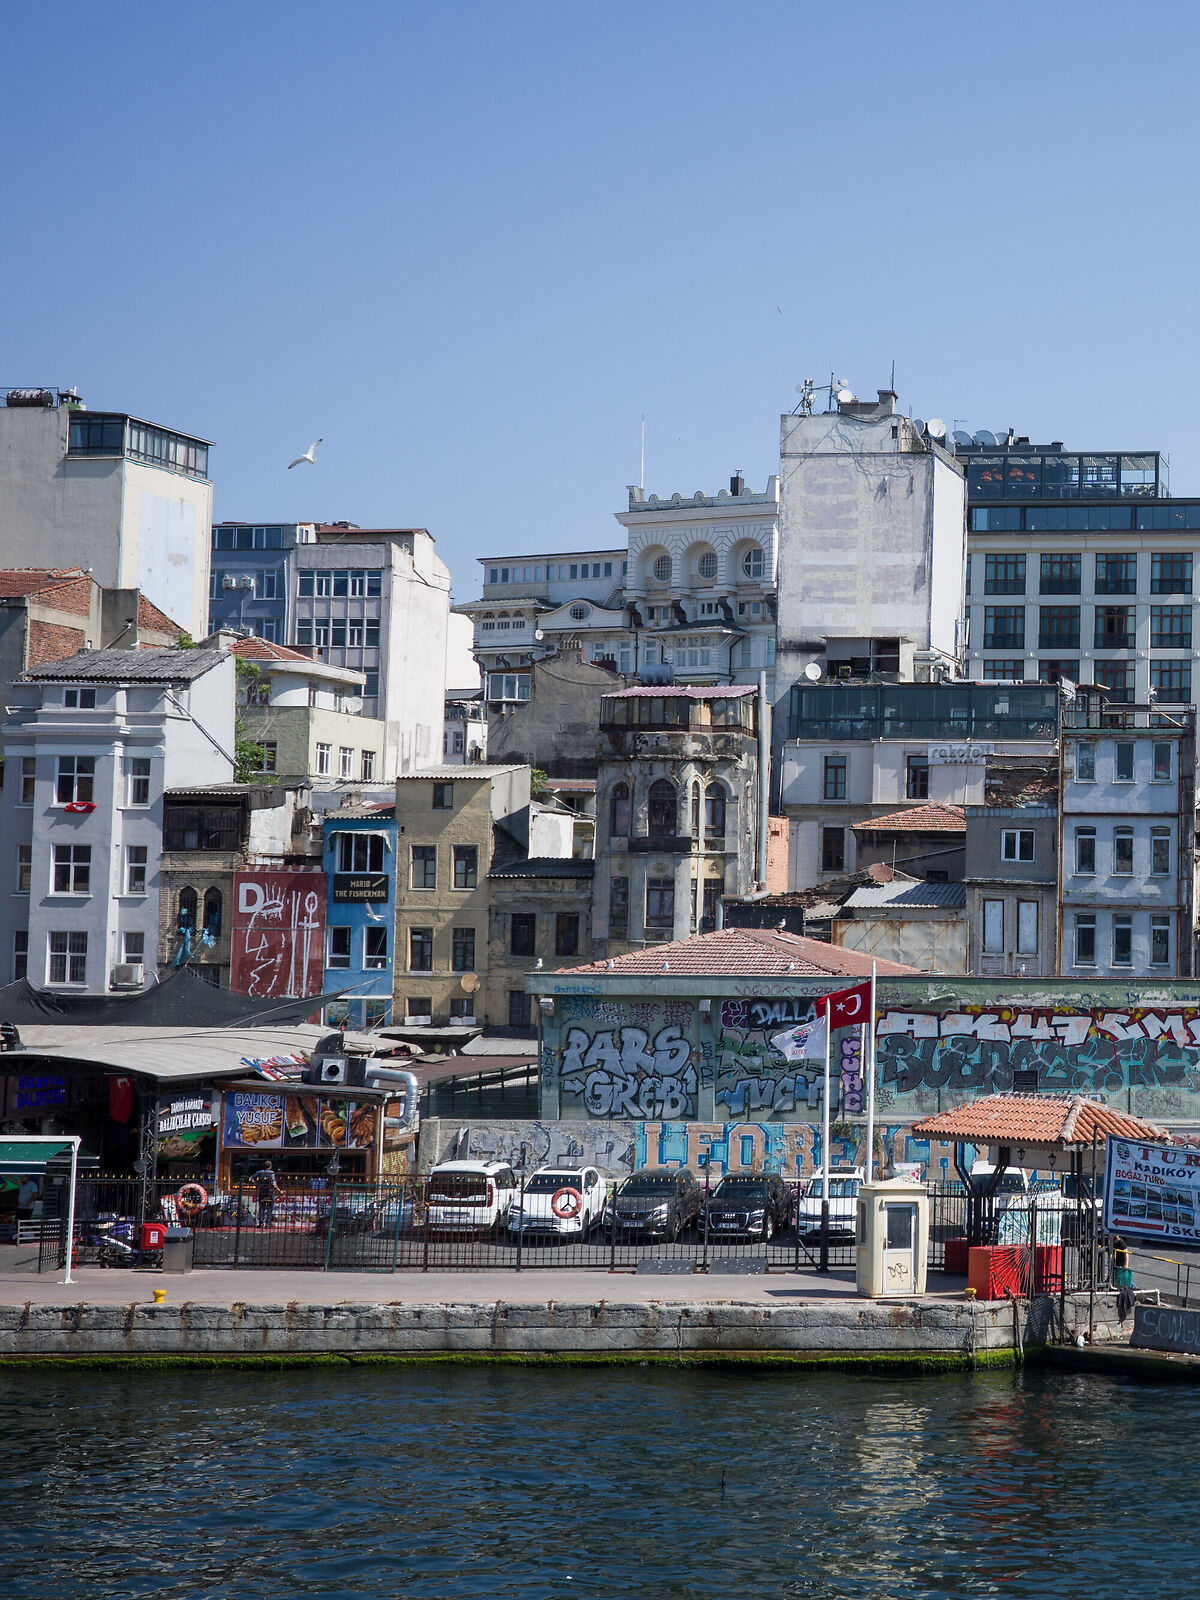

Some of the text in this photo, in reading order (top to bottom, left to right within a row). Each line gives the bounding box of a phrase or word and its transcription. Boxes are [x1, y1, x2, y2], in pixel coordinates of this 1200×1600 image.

[350, 880, 371, 888] MARIO
[559, 1026, 691, 1080] PARS
[234, 1093, 281, 1108] BALIKÇI
[236, 1111, 277, 1125] YUSUF
[1115, 1169, 1143, 1182] BOĞAZ
[1144, 1174, 1165, 1186] TURU
[1134, 1161, 1196, 1179] KADIKÖY
